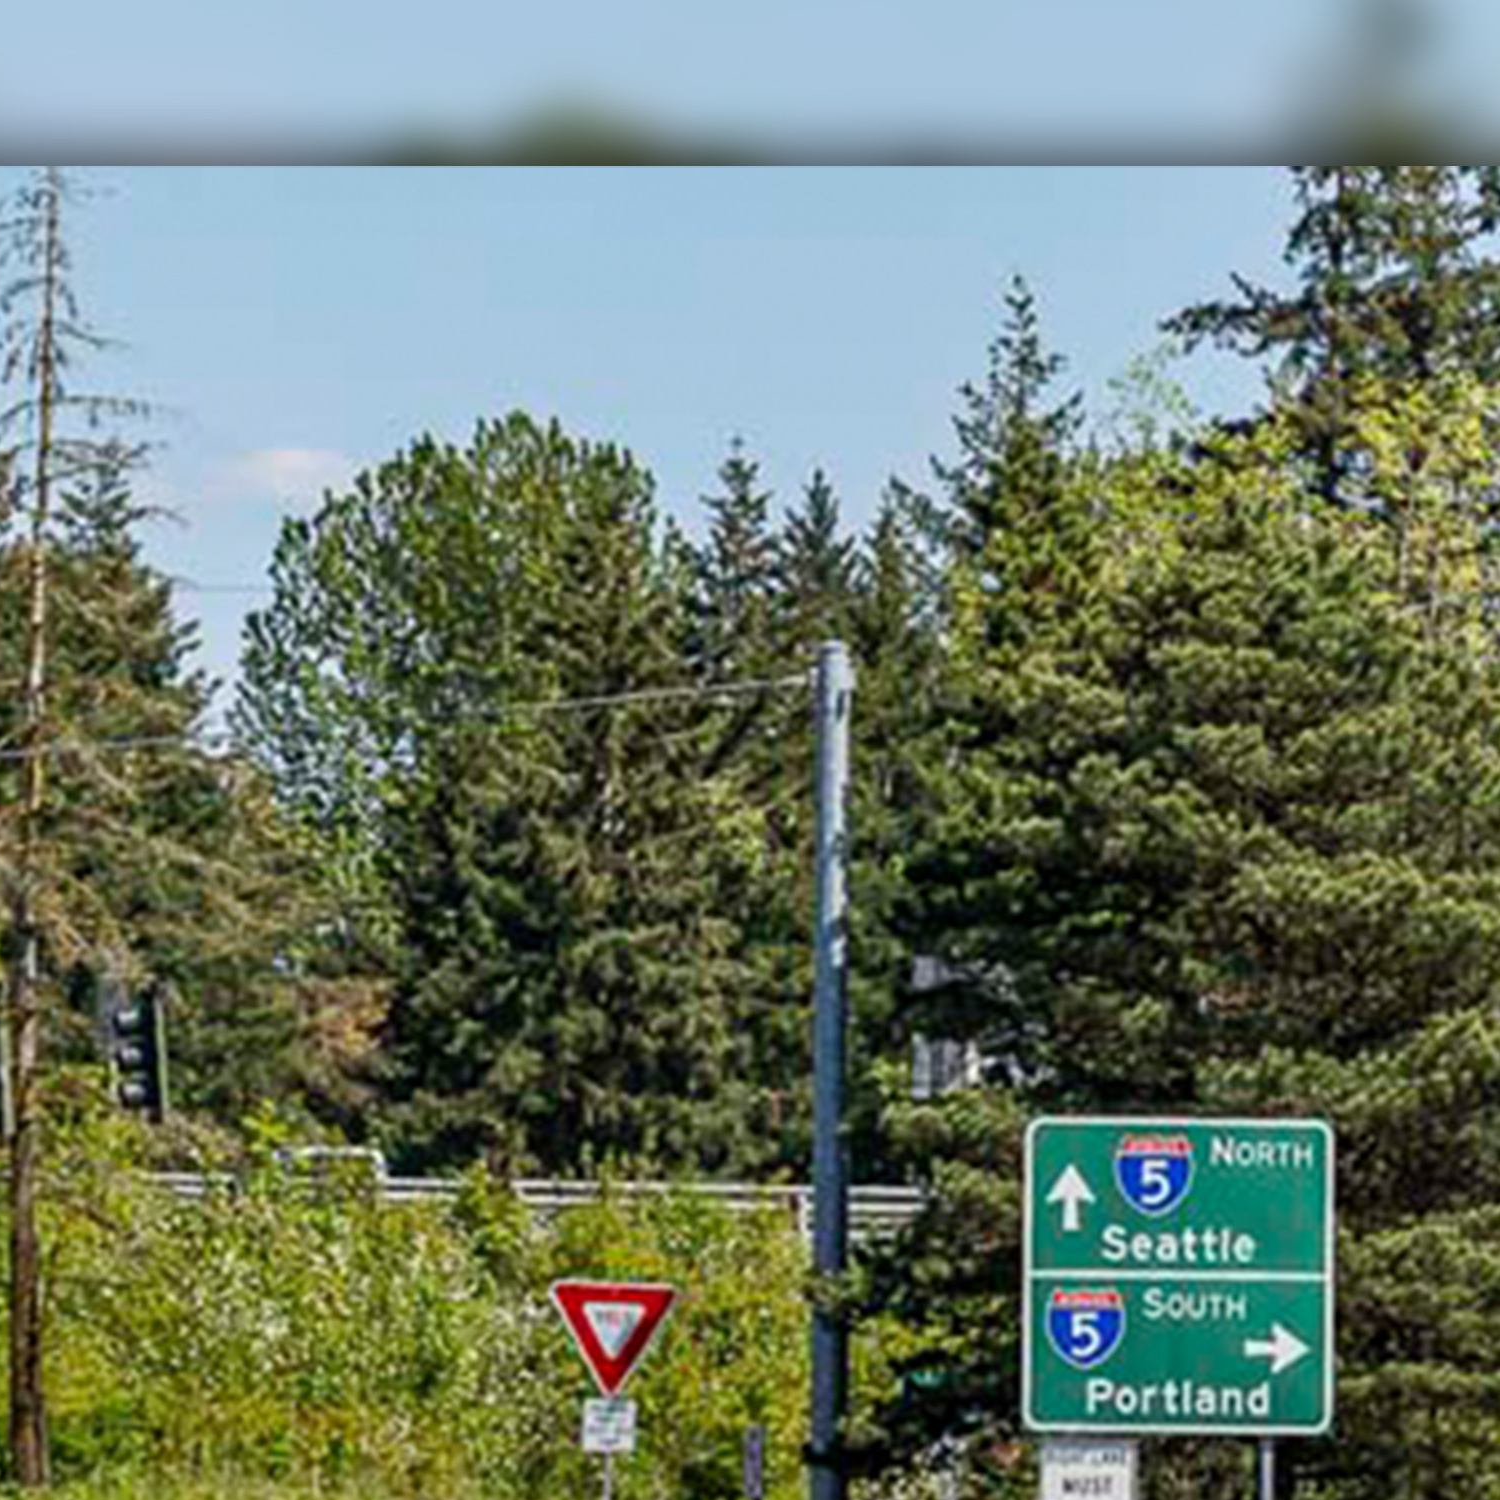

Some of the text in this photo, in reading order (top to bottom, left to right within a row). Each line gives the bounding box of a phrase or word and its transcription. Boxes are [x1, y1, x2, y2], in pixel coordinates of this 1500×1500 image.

[1140, 1136, 1313, 1205] 5 NORTH
[1101, 1225, 1256, 1263] Seattle
[1070, 1287, 1246, 1357] 5 SOUTH
[1085, 1377, 1270, 1416] Portland
[1062, 1476, 1113, 1495] MUST
